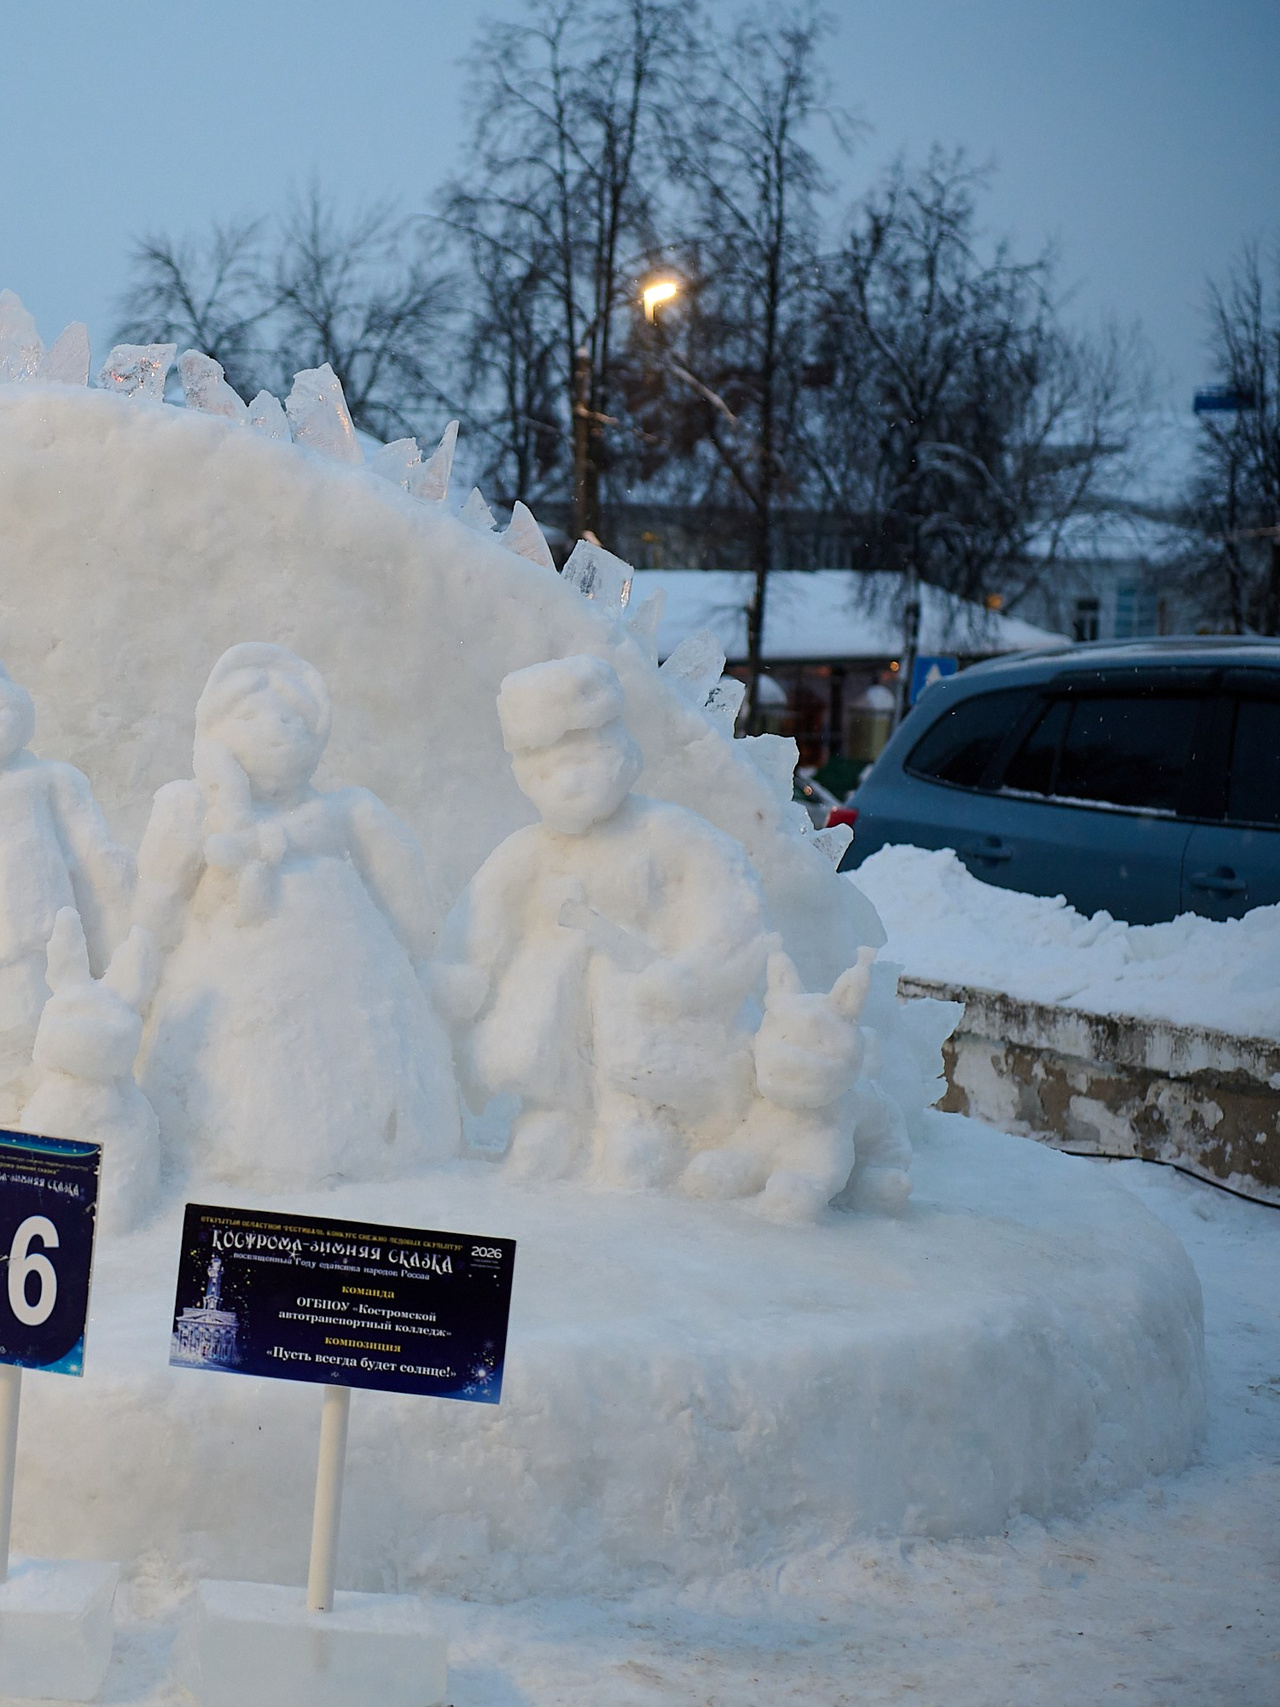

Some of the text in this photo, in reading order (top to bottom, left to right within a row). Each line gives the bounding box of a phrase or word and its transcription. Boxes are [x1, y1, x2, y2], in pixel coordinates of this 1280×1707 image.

[388, 1248, 453, 1275] СКАЗКА
[471, 1246, 503, 1259] 2026
[8, 1215, 60, 1326] 6
[295, 1257, 317, 1269] Году
[363, 1266, 399, 1279] народов
[400, 1269, 430, 1281] России
[341, 1285, 395, 1299] команда
[296, 1296, 437, 1323] ОГБПОУ «Костромской
[278, 1309, 452, 1338] автотранспортный колледж»
[324, 1336, 402, 1353] композиция
[266, 1346, 457, 1378] «Пусть всегда будет солнце!»
